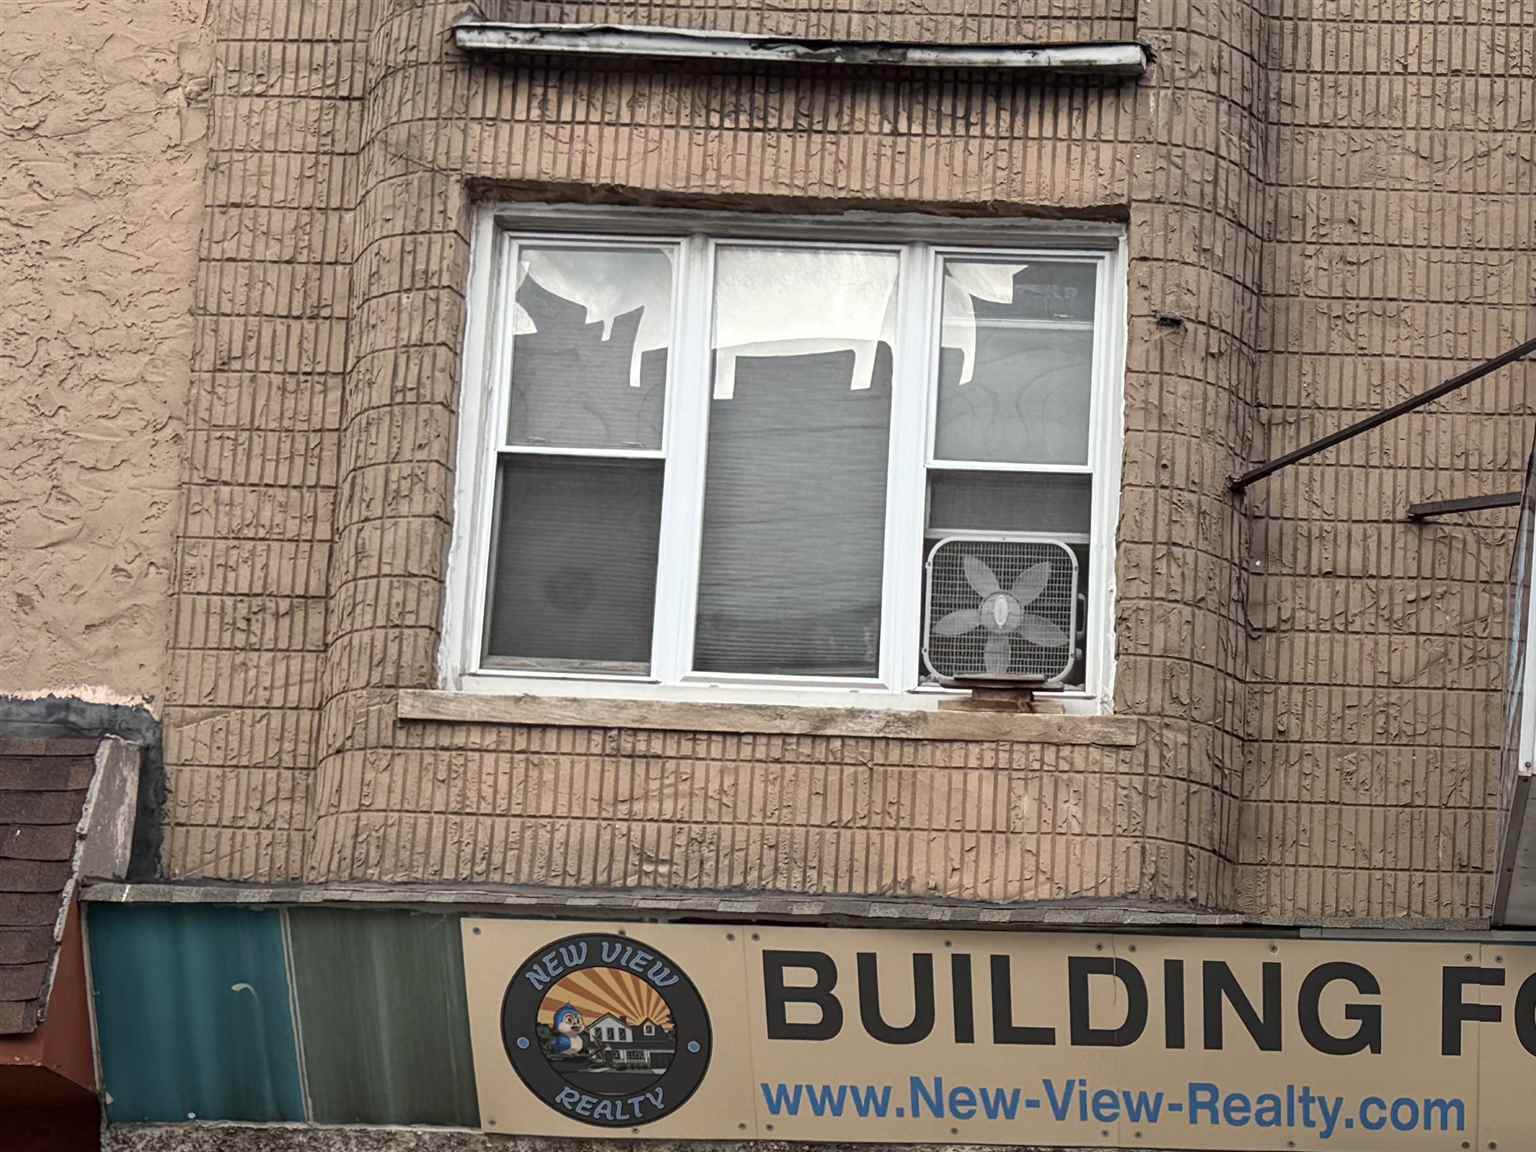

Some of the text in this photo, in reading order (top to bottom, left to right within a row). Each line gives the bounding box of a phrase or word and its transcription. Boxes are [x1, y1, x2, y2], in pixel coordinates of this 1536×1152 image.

[525, 941, 680, 991] NEW VIEW
[762, 949, 1383, 1055] BUILDING
[554, 1086, 666, 1121] REALTY
[760, 1075, 1466, 1139] www.New-View-Realty.com
